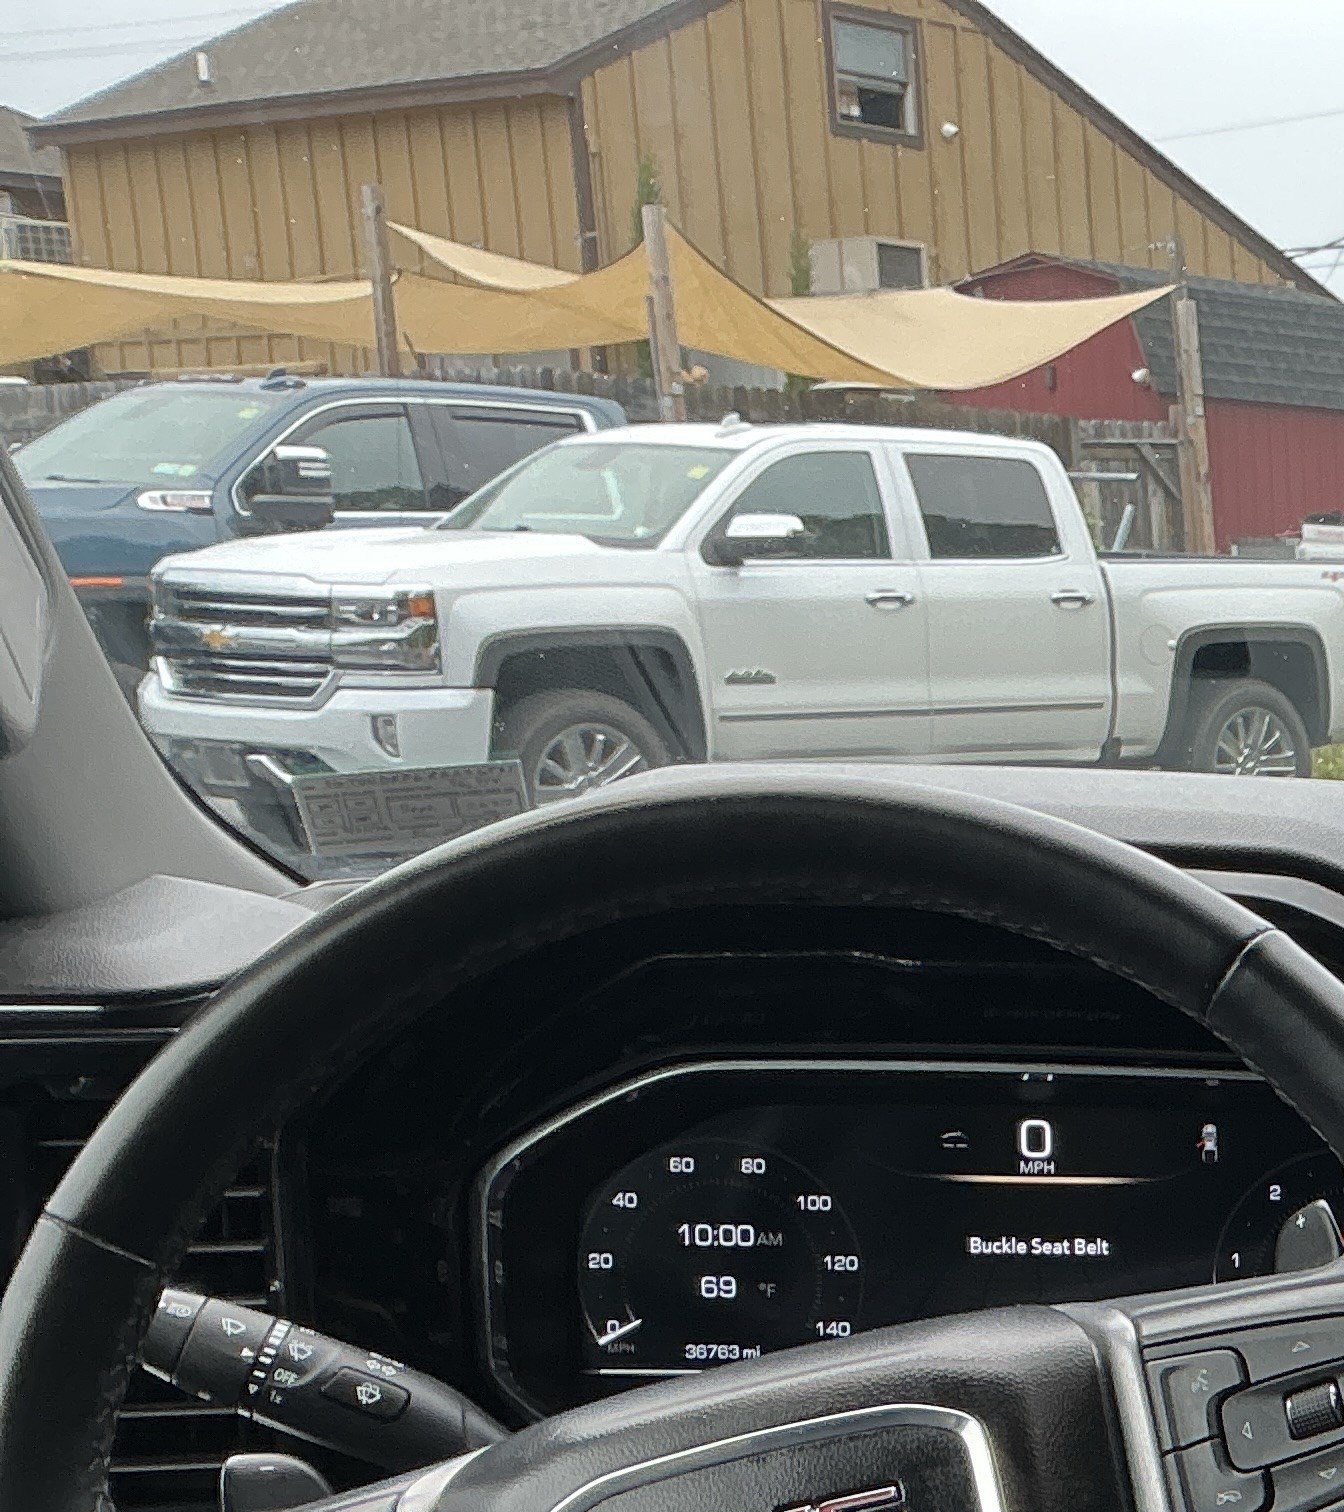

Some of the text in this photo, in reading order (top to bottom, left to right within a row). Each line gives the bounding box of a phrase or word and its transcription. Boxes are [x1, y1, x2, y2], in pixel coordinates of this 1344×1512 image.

[1020, 1119, 1051, 1159] 0
[669, 1156, 694, 1173] 60
[741, 1158, 766, 1174] 80
[1019, 1161, 1055, 1175] MPH
[612, 1192, 637, 1208] 40
[1269, 1184, 1281, 1201] 2
[797, 1195, 832, 1210] 100
[678, 1224, 783, 1247] 10:00 AM
[969, 1236, 1110, 1257] Buckle Seat Belt
[588, 1253, 612, 1269] 20
[823, 1255, 858, 1271] 120
[1231, 1253, 1240, 1269] 1
[701, 1276, 736, 1298] 69
[606, 1319, 619, 1335] 0
[815, 1321, 851, 1337] 140
[685, 1344, 761, 1359] 36763 mi
[274, 1368, 298, 1384] OFF
